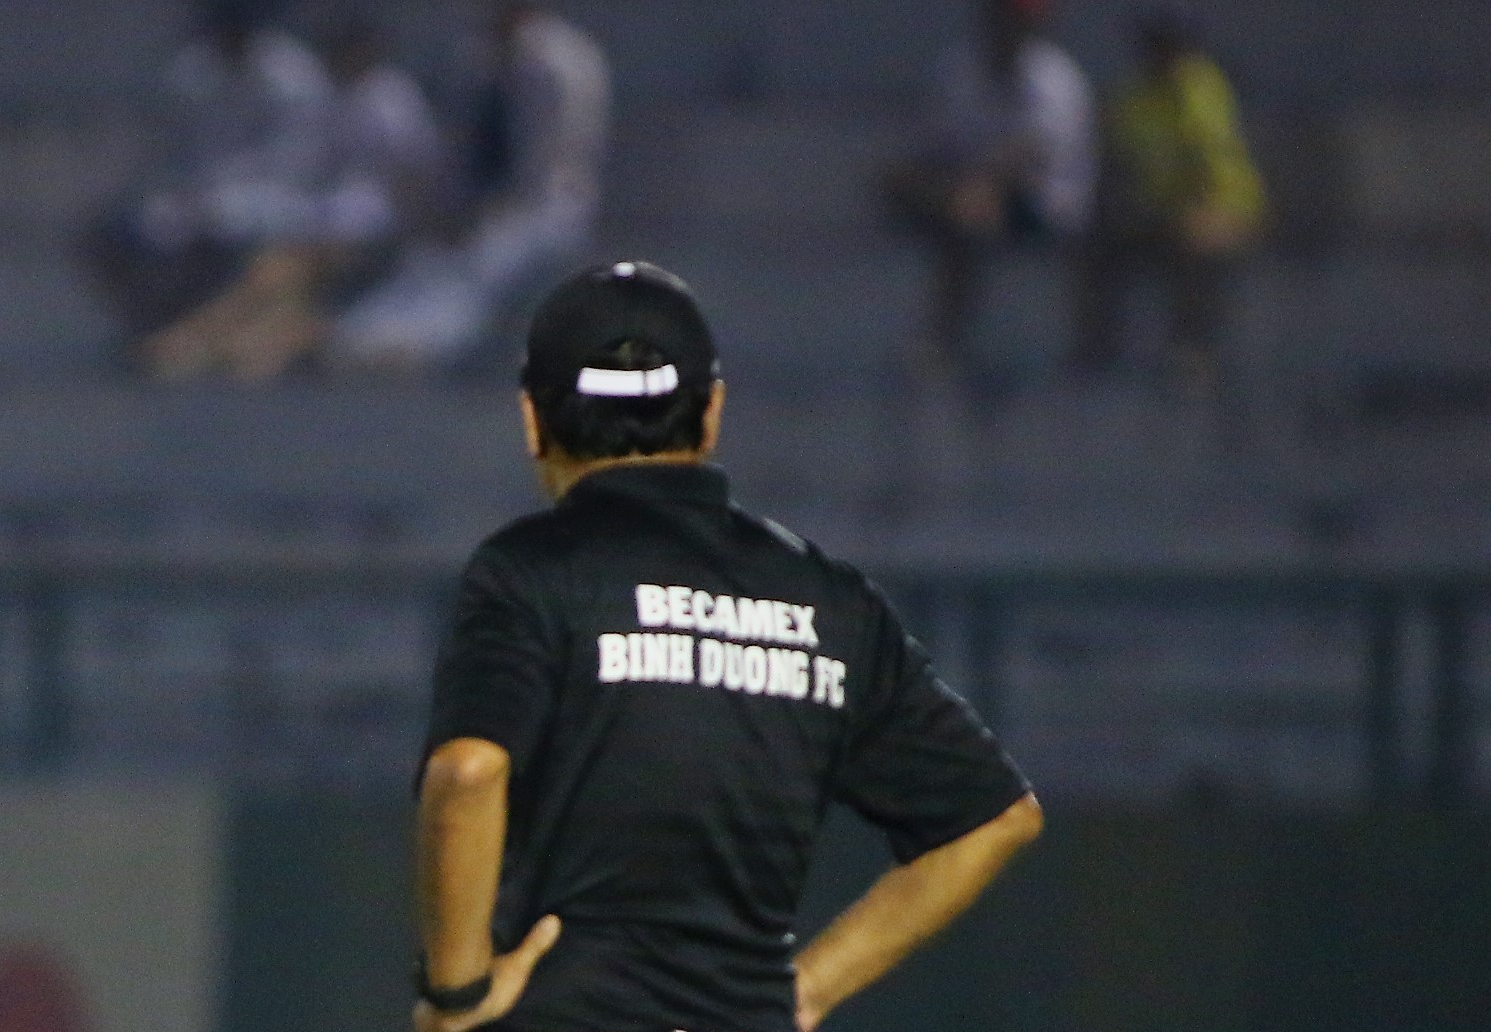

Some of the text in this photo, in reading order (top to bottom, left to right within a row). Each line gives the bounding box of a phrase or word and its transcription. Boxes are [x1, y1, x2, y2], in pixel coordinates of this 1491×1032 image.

[635, 583, 819, 647] BECAMEX
[597, 633, 846, 708] BINH DUONG FC
